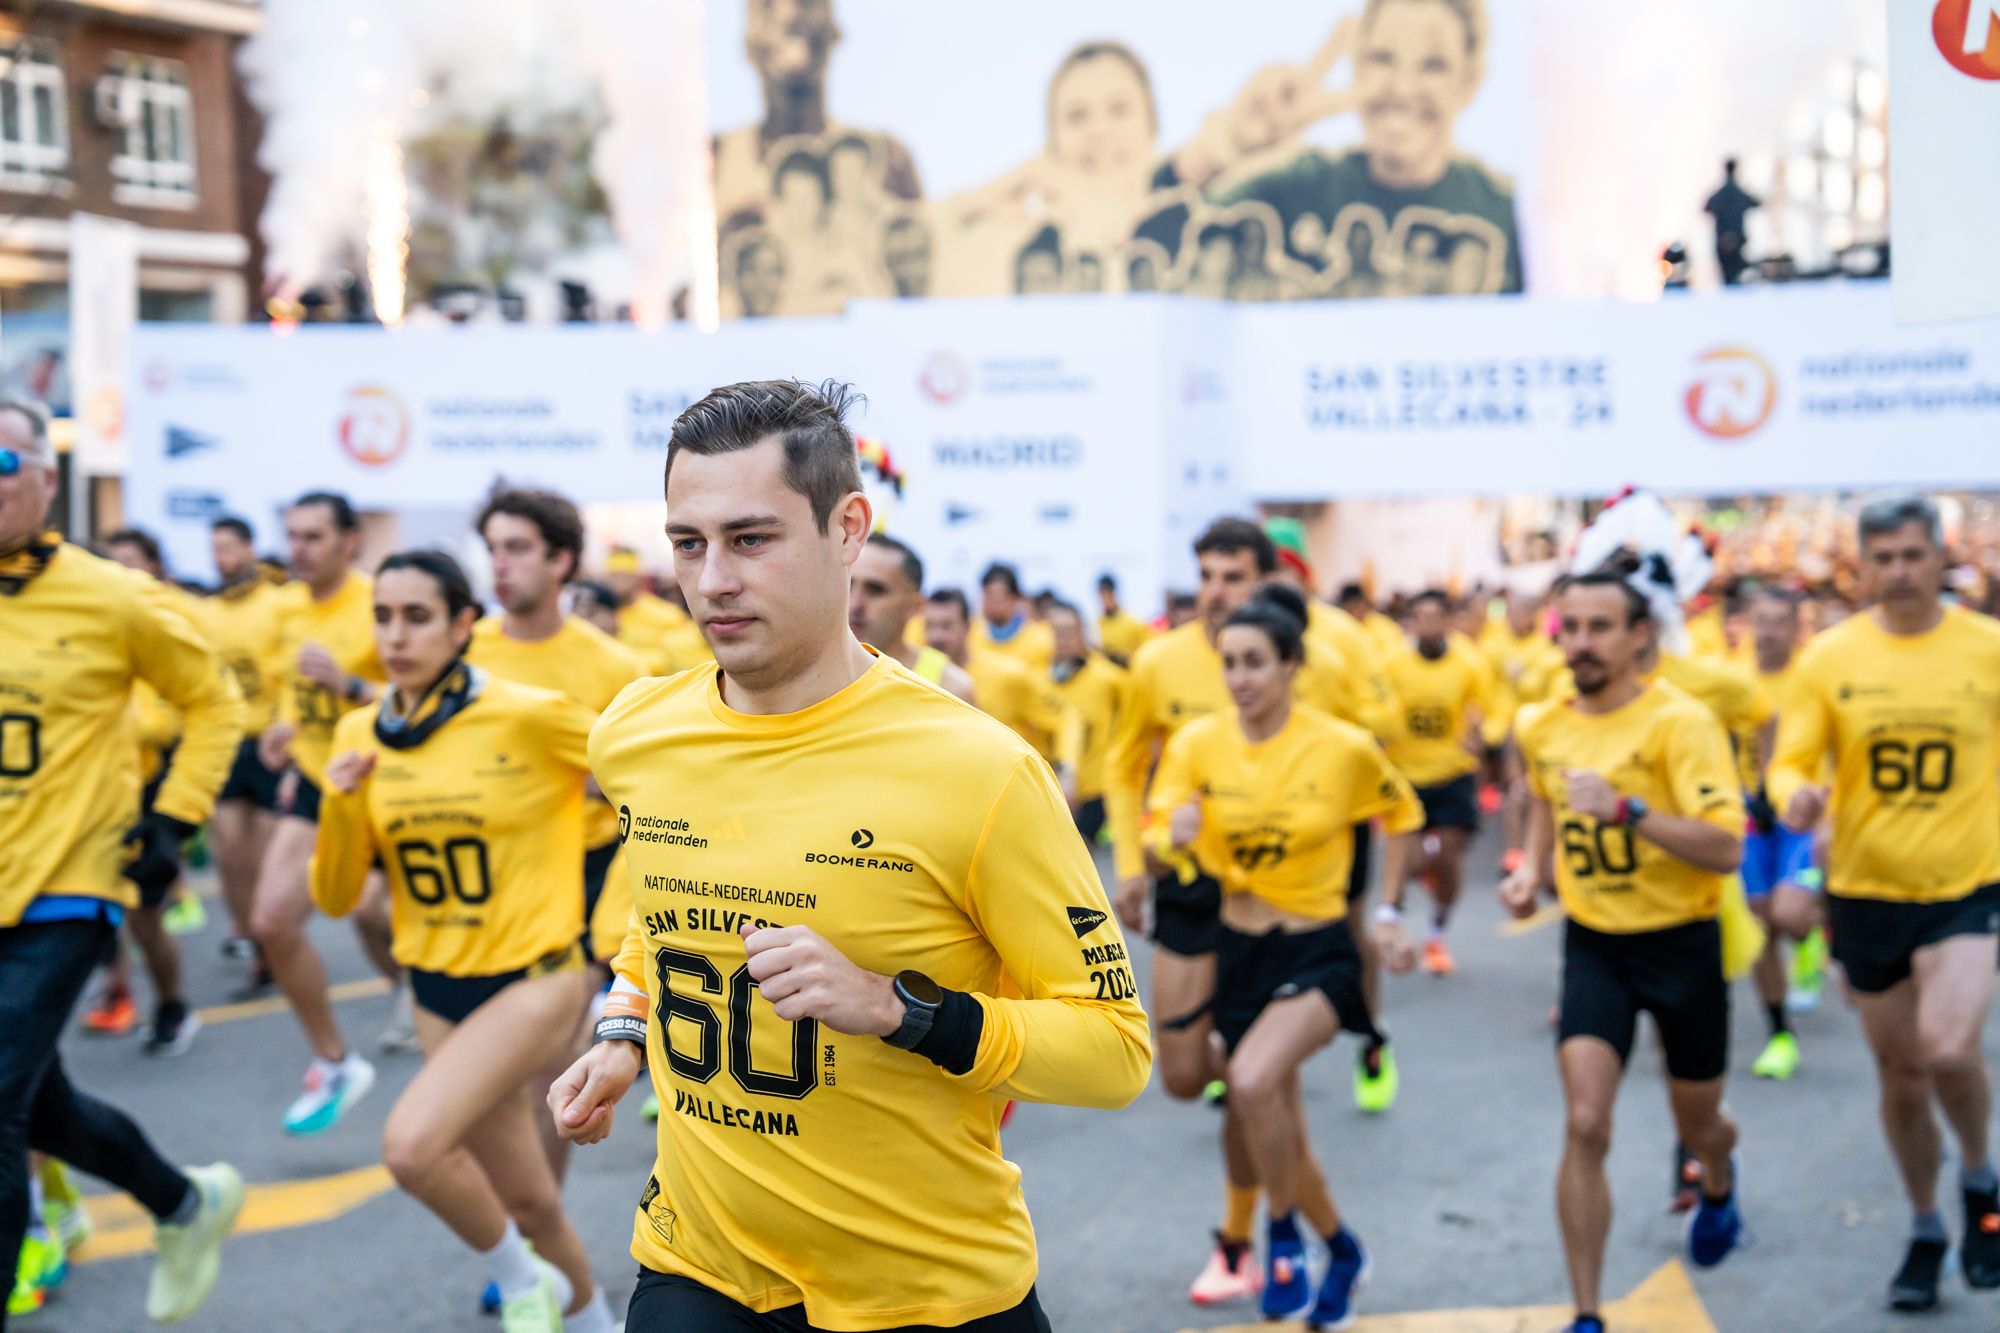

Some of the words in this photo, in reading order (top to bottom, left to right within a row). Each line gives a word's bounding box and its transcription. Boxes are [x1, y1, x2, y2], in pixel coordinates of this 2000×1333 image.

[934, 435, 1083, 467] MADRID
[1869, 739, 1955, 795] 60
[635, 815, 690, 832] nationale
[633, 829, 708, 849] nederlanden
[396, 834, 492, 906] 60
[805, 852, 914, 872] BOOMERANG
[644, 874, 817, 910] NATIONALE-NEDERLANDEN
[645, 909, 679, 936] SAN
[655, 946, 819, 1100] 60
[824, 1044, 836, 1068] 1964
[825, 1071, 836, 1087] EST.
[674, 1088, 800, 1136] VALLECANA
